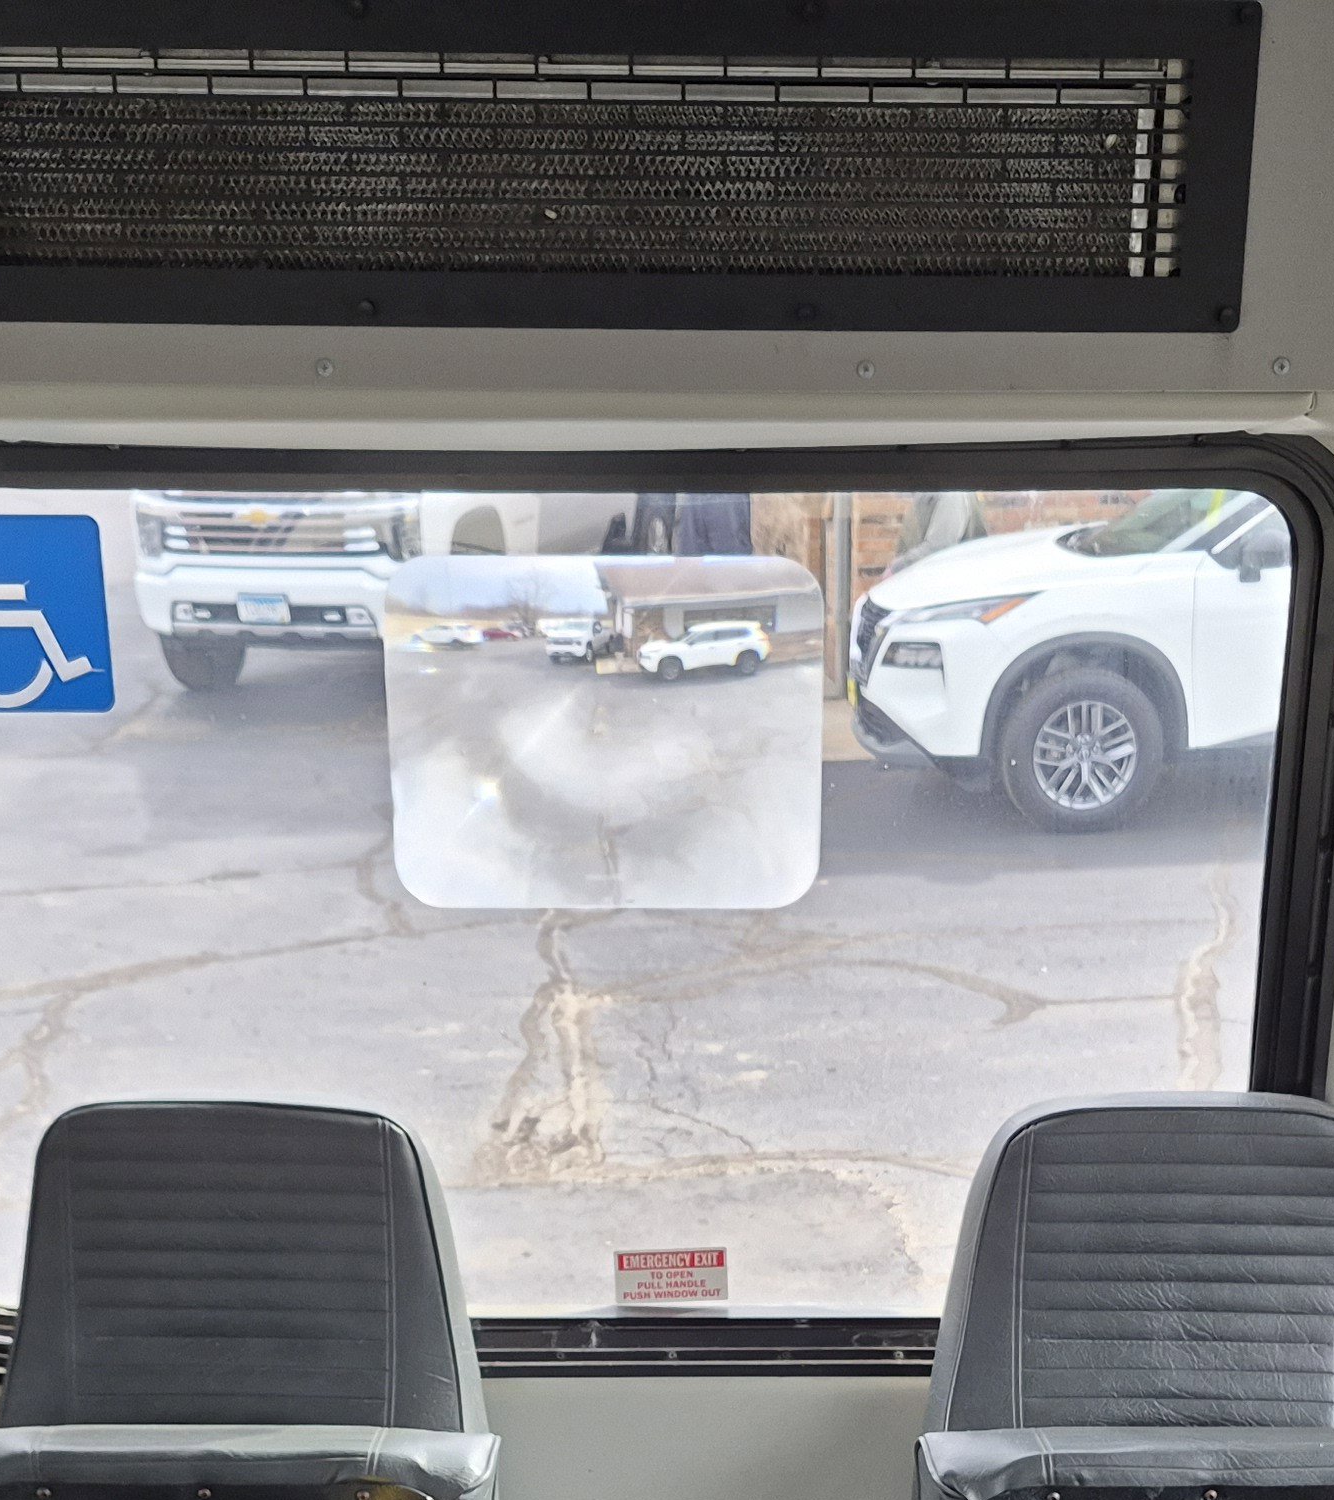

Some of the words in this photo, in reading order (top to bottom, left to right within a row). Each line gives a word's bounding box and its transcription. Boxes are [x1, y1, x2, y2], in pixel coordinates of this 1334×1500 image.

[623, 1253, 691, 1269] EMERGENCY
[694, 1251, 719, 1267] EXIT
[650, 1271, 663, 1280] TO
[666, 1270, 693, 1279] OPEN
[637, 1281, 663, 1290] PULL
[666, 1279, 706, 1289] HANDLE
[623, 1291, 651, 1300] PUSH
[654, 1289, 698, 1299] WINDOW
[701, 1288, 721, 1298] OUT
